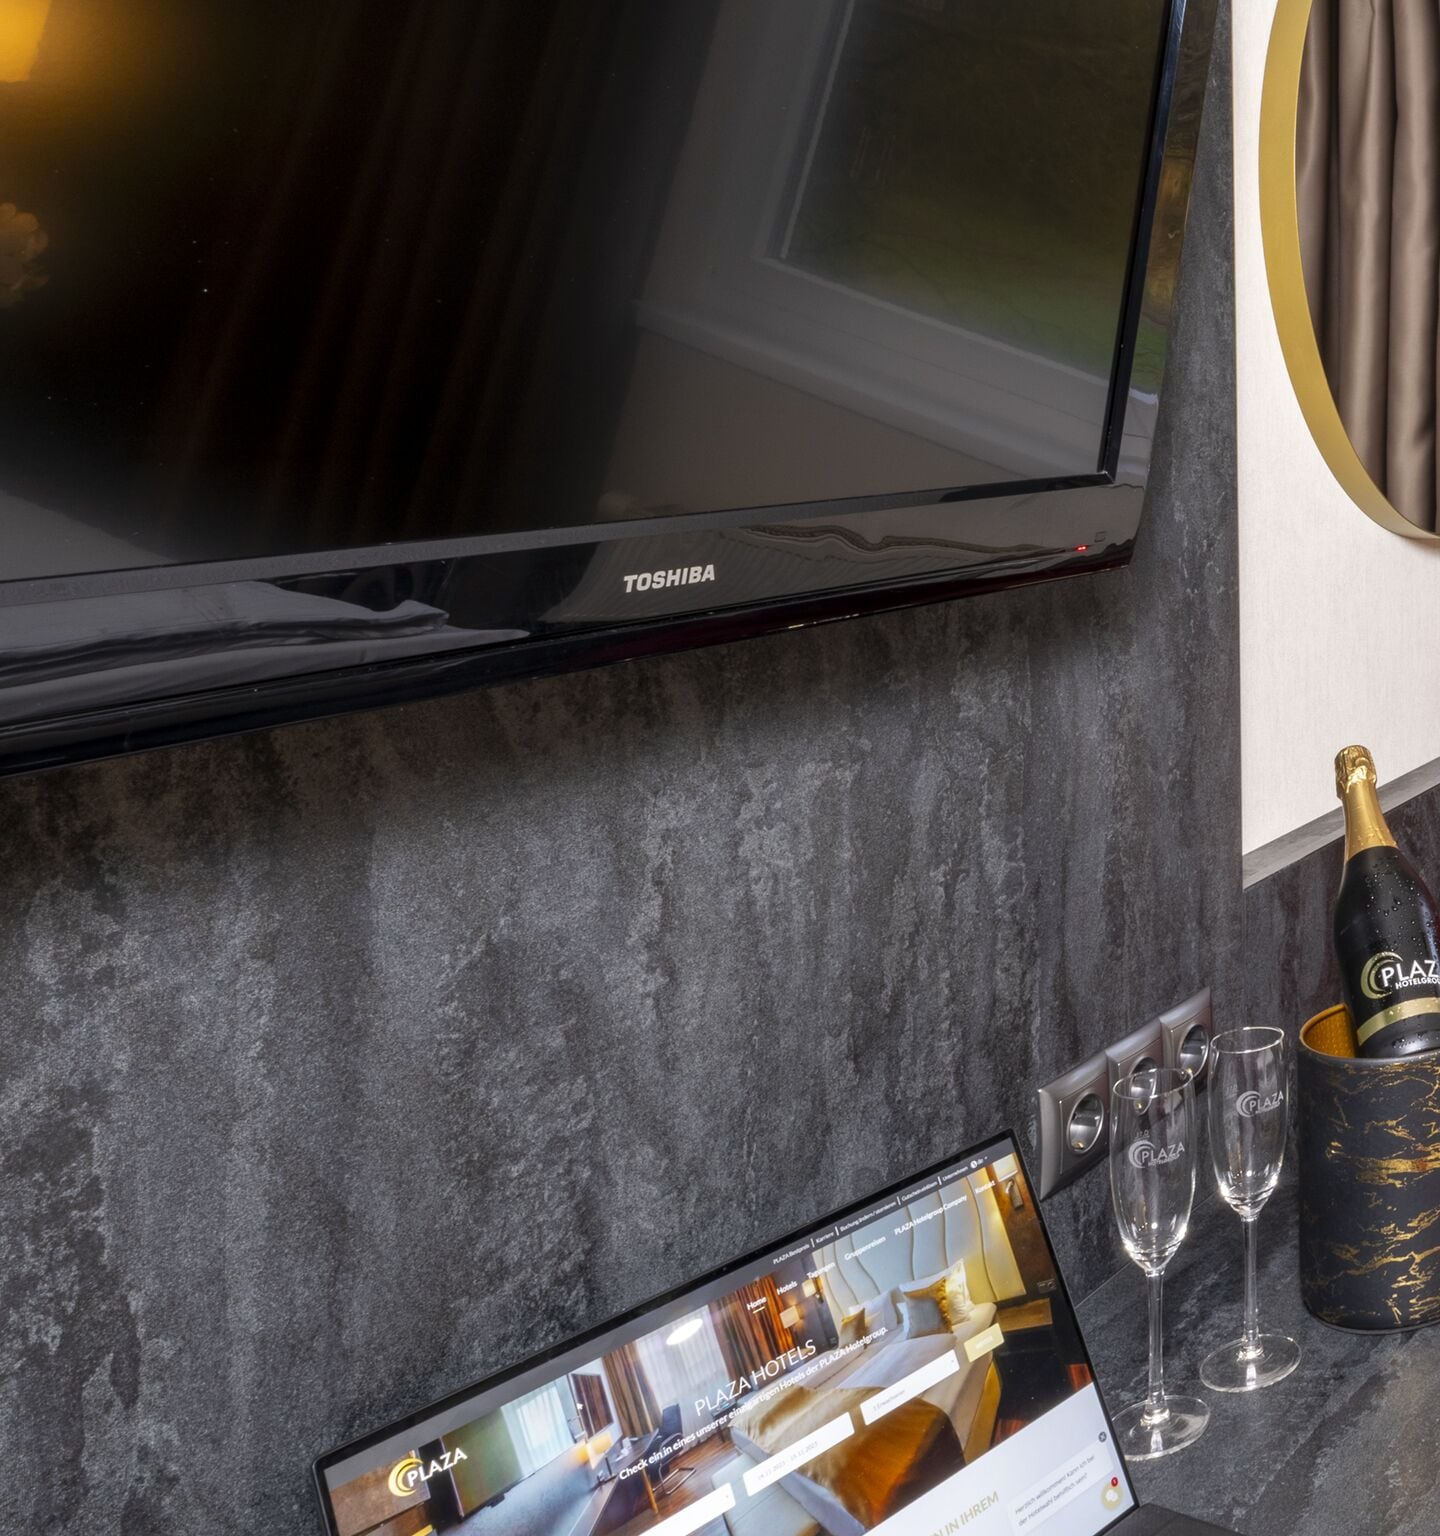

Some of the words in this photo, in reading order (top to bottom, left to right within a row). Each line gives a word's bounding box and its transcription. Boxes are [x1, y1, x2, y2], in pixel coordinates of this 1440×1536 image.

[623, 564, 715, 593] TOSHIBA
[1249, 1090, 1284, 1112] PLAZA
[1141, 1141, 1185, 1163] PLAZA
[894, 1220, 914, 1235] PLAZA
[776, 1280, 798, 1295] Hotels
[746, 1296, 767, 1310] Home
[694, 1376, 751, 1416] PLAZA
[751, 1339, 816, 1385] HOTELS
[619, 1458, 648, 1480] Check
[648, 1450, 663, 1464] ein
[663, 1444, 673, 1458] in
[673, 1433, 696, 1450] eines
[696, 1414, 728, 1437] unserer
[780, 1372, 805, 1390] Hotels
[805, 1363, 820, 1377] der
[820, 1347, 847, 1369] PLAZA
[846, 1326, 888, 1353] Hotelgroup.
[407, 1447, 468, 1487] PLAZA
[959, 1490, 999, 1526] IHREM
